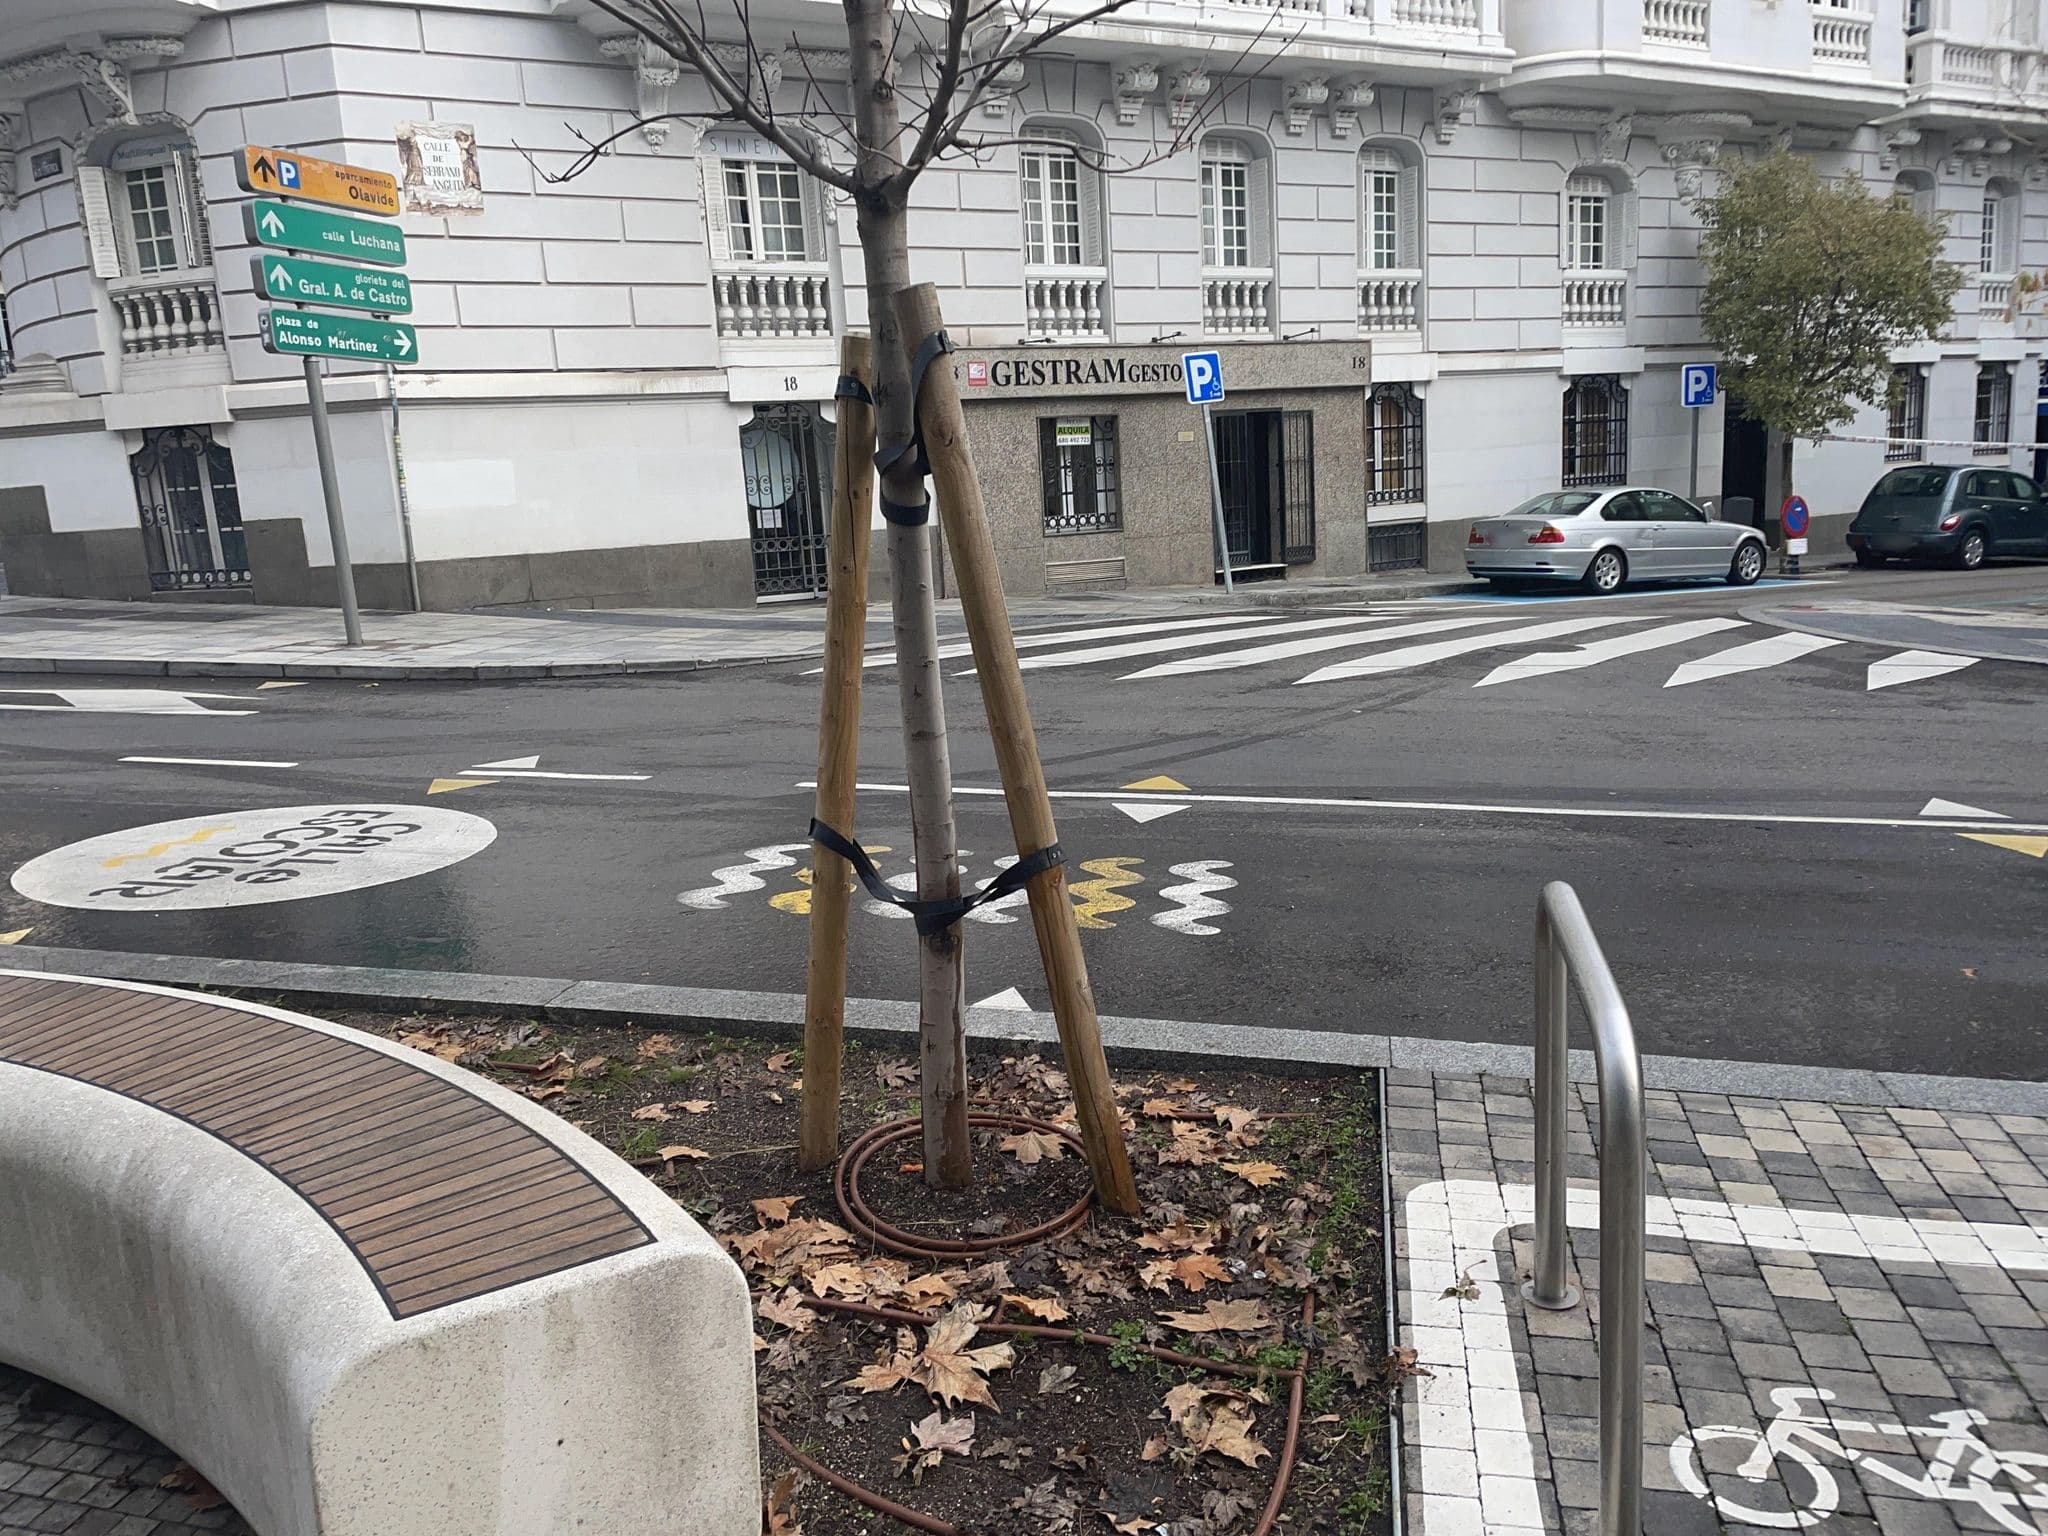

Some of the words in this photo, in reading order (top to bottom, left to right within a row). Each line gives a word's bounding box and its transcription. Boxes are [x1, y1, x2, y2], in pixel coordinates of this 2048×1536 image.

[423, 142, 450, 153] CALLE
[432, 154, 444, 163] DE
[280, 161, 296, 186] P
[335, 169, 392, 190] aparcamiento
[423, 165, 461, 178] SERRANO
[349, 185, 395, 207] Olavide
[322, 231, 345, 243] calle
[351, 230, 401, 252] Luchana
[355, 273, 388, 287] glorieta
[392, 279, 406, 289] del
[298, 279, 330, 297] Gral.
[334, 284, 347, 299] A.
[351, 287, 365, 301] de
[369, 289, 408, 306] Castro
[275, 315, 302, 328] plaza
[307, 319, 319, 330] de
[279, 330, 322, 348] Alonso
[1352, 356, 1366, 369] 18
[991, 358, 1126, 388] GESTRAM
[1189, 358, 1213, 398] P
[783, 376, 798, 391] 18
[1688, 369, 1708, 403] P
[1058, 426, 1089, 435] ALQUILA
